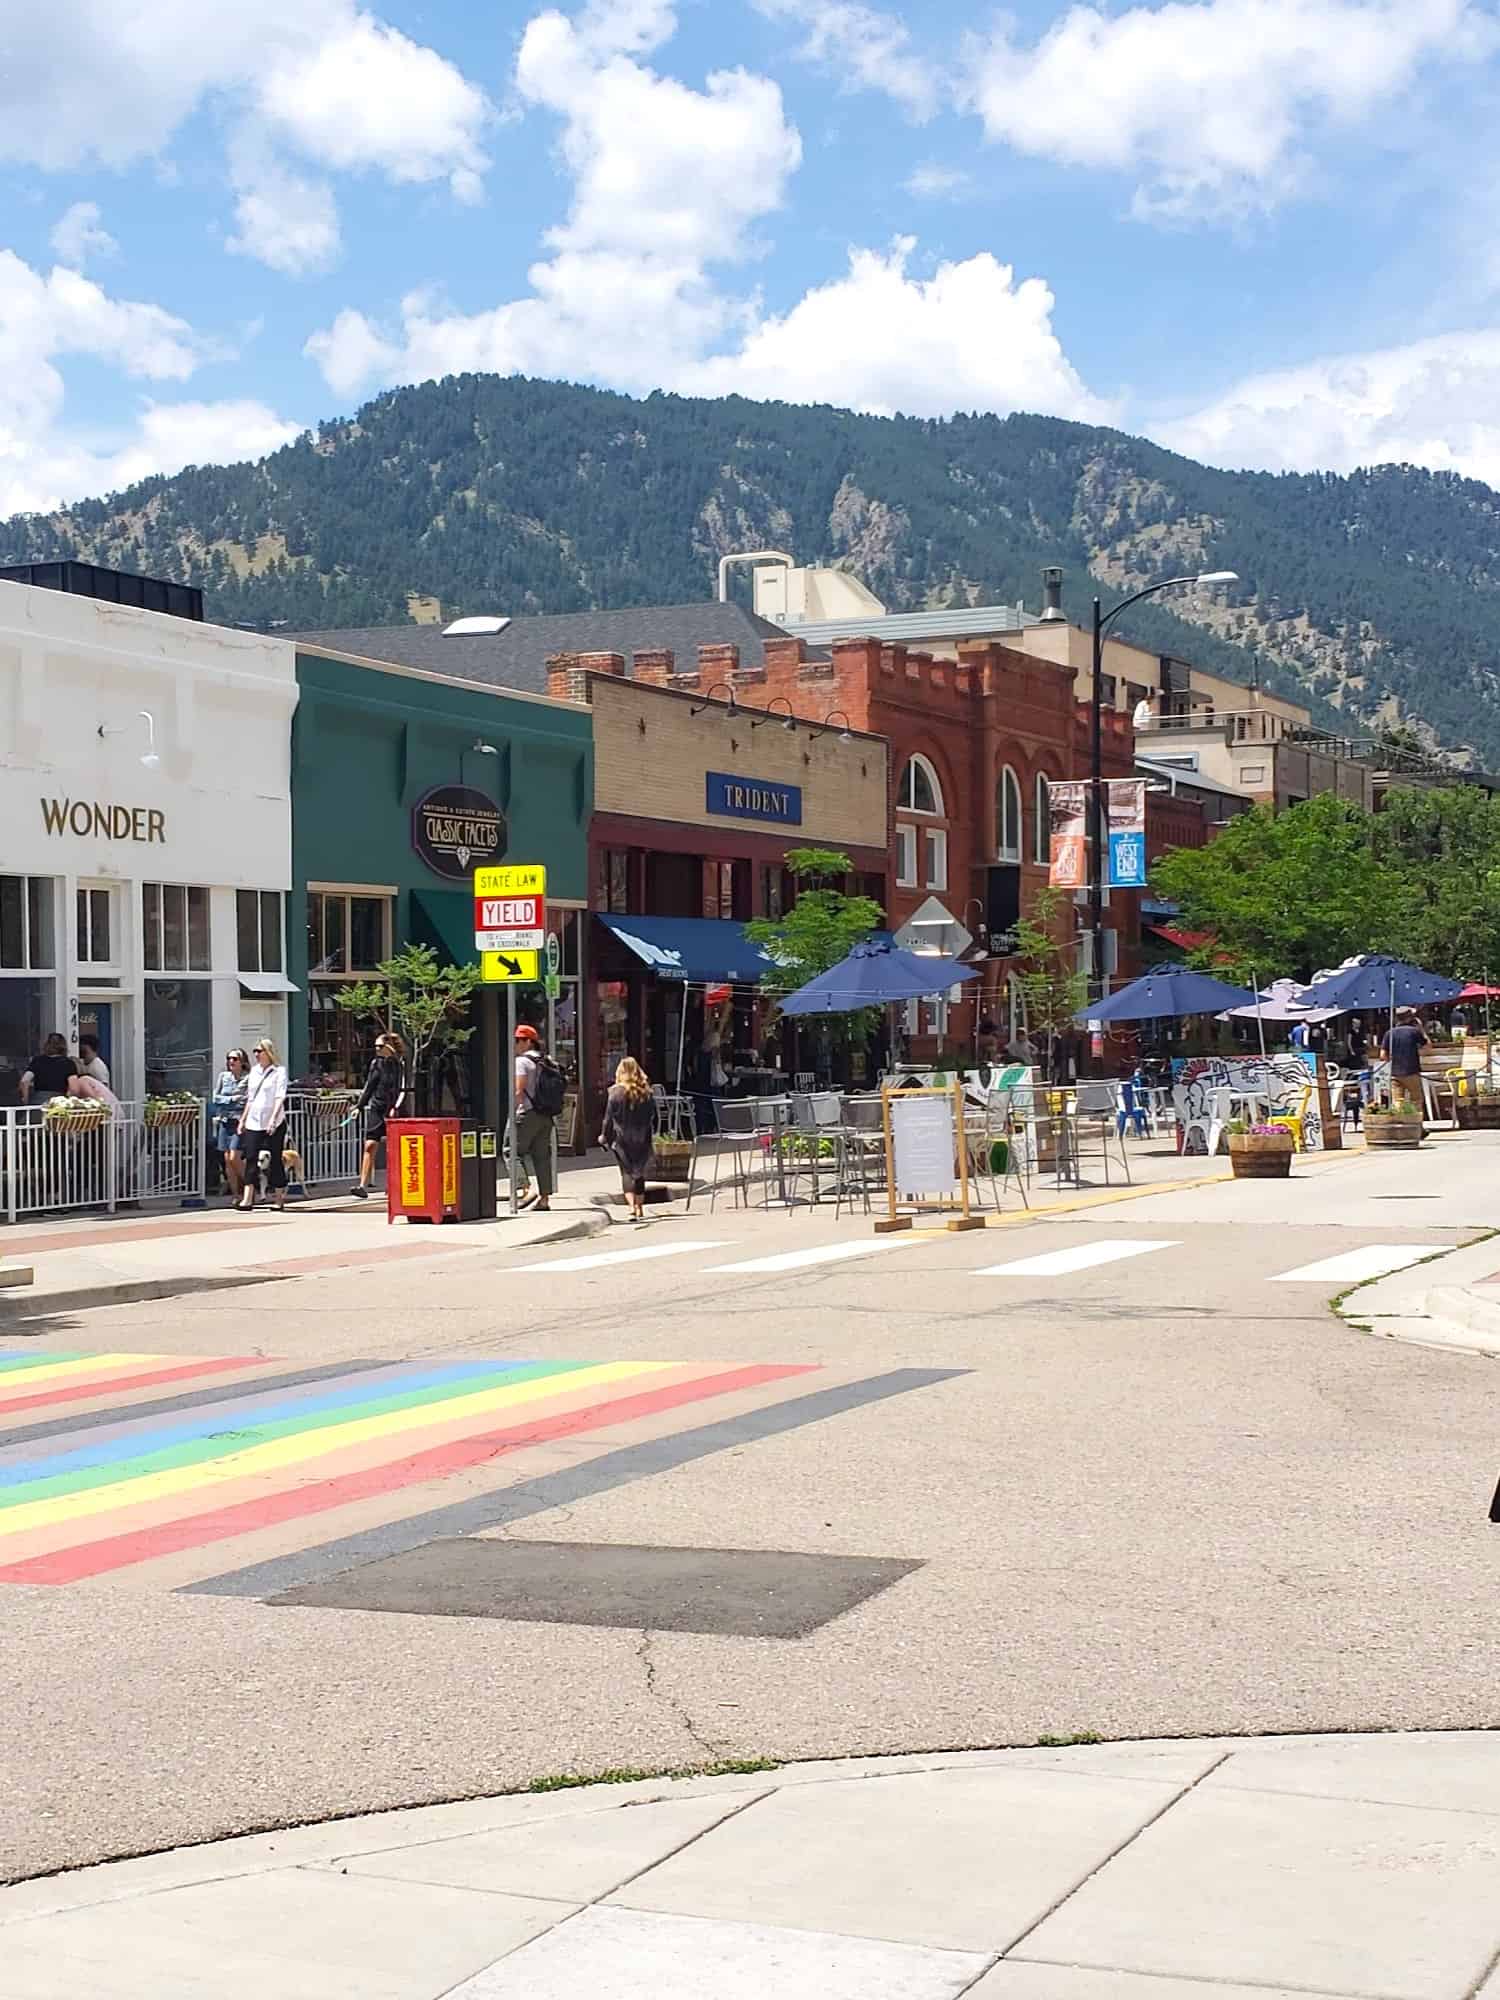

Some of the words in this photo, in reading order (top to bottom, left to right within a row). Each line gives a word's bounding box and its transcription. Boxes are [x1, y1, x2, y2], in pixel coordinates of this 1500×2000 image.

[724, 784, 789, 815] TRIDENT
[40, 797, 166, 843] WONDER
[426, 818, 464, 844] CLASSIC
[465, 821, 498, 847] FACETS
[1115, 843, 1138, 857] WEST
[1117, 858, 1138, 872] END
[480, 875, 511, 889] STATE
[516, 874, 537, 887] LAW
[485, 902, 534, 924] YIELD
[406, 1137, 419, 1194] Westword
